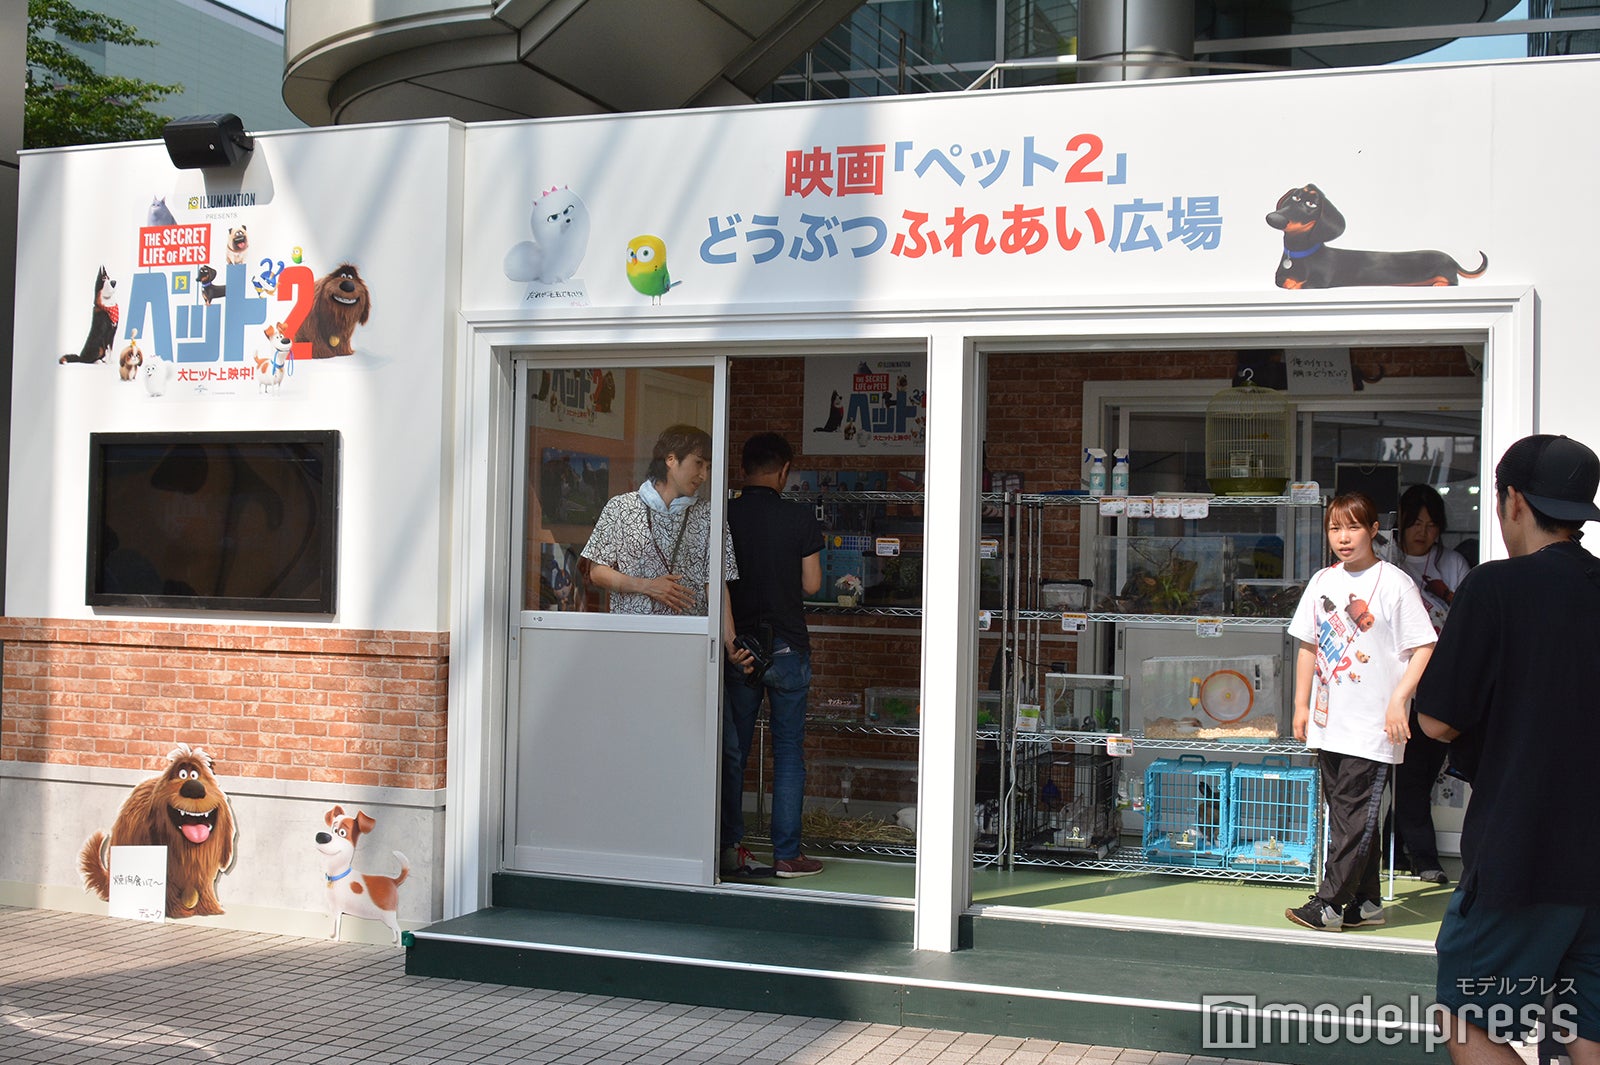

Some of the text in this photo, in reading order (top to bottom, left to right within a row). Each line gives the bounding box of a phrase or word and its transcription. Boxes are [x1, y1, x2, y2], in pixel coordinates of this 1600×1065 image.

[784, 133, 1127, 199] 映画「ペット2」
[199, 193, 256, 209] ILLUMINATION
[205, 212, 238, 220] PRESENTS
[144, 227, 207, 246] THE SECRET
[700, 196, 1223, 265] どうぶつふれあい広場
[142, 245, 206, 264] LIFE OF PETS
[124, 264, 315, 363] ペット2
[177, 366, 255, 381] 大ヒット上映中!
